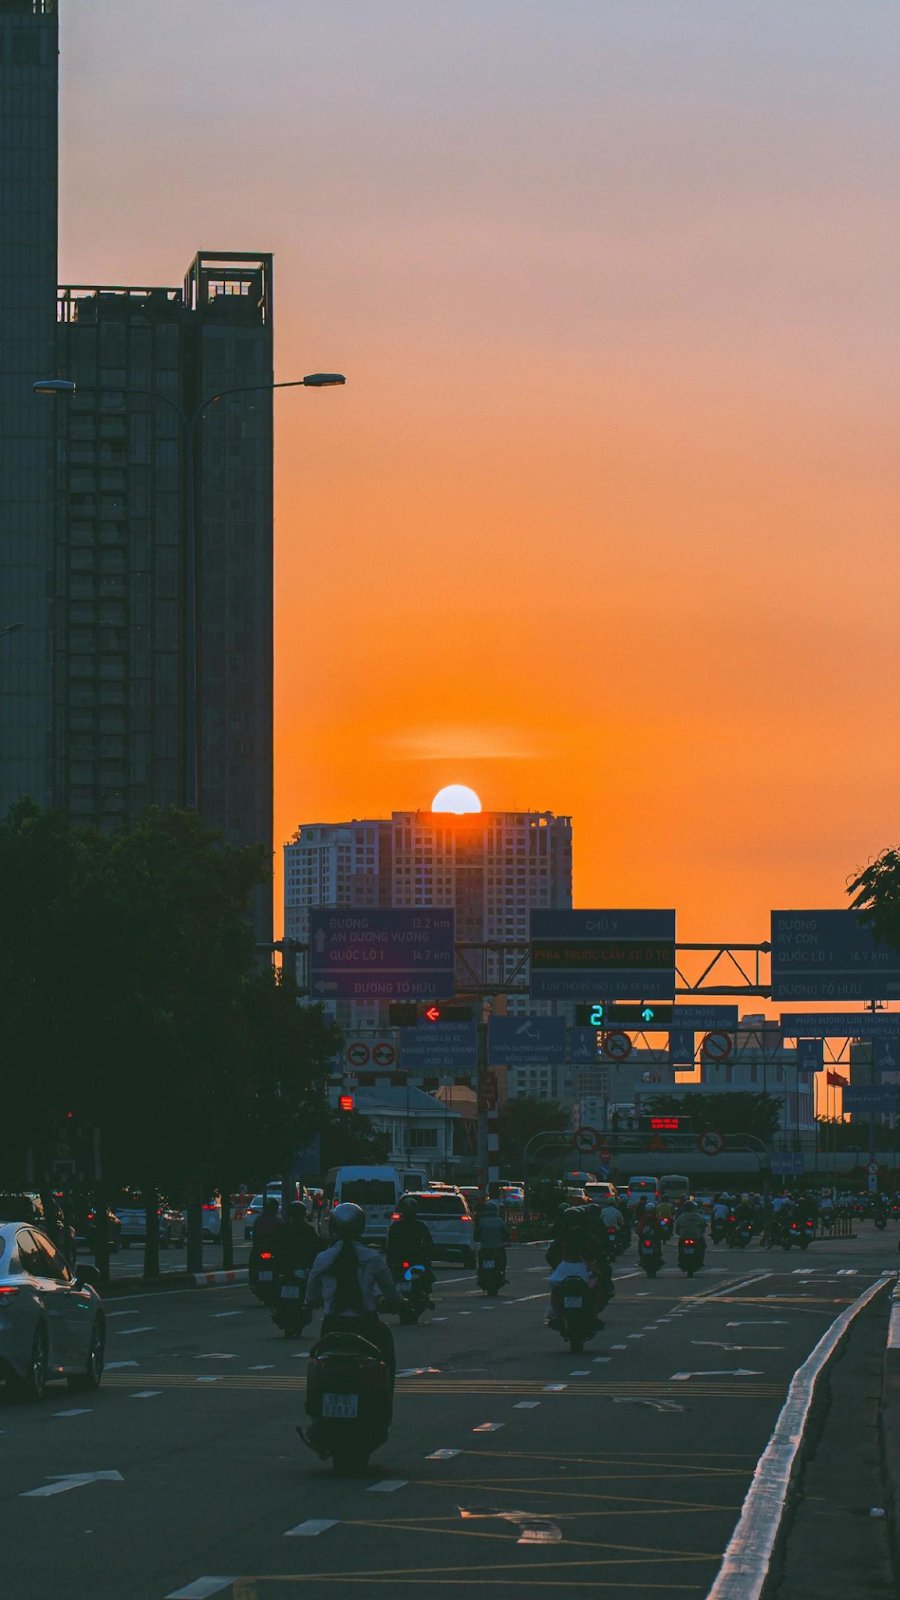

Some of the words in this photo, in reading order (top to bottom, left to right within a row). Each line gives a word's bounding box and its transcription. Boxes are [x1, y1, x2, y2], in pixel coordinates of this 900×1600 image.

[412, 918, 431, 929] 12.2
[433, 918, 450, 929] km
[329, 931, 347, 942] AN
[379, 950, 385, 961] 1
[412, 950, 431, 961] 14.7
[433, 949, 450, 961] km
[871, 950, 889, 961] km
[591, 1005, 603, 1025] 2
